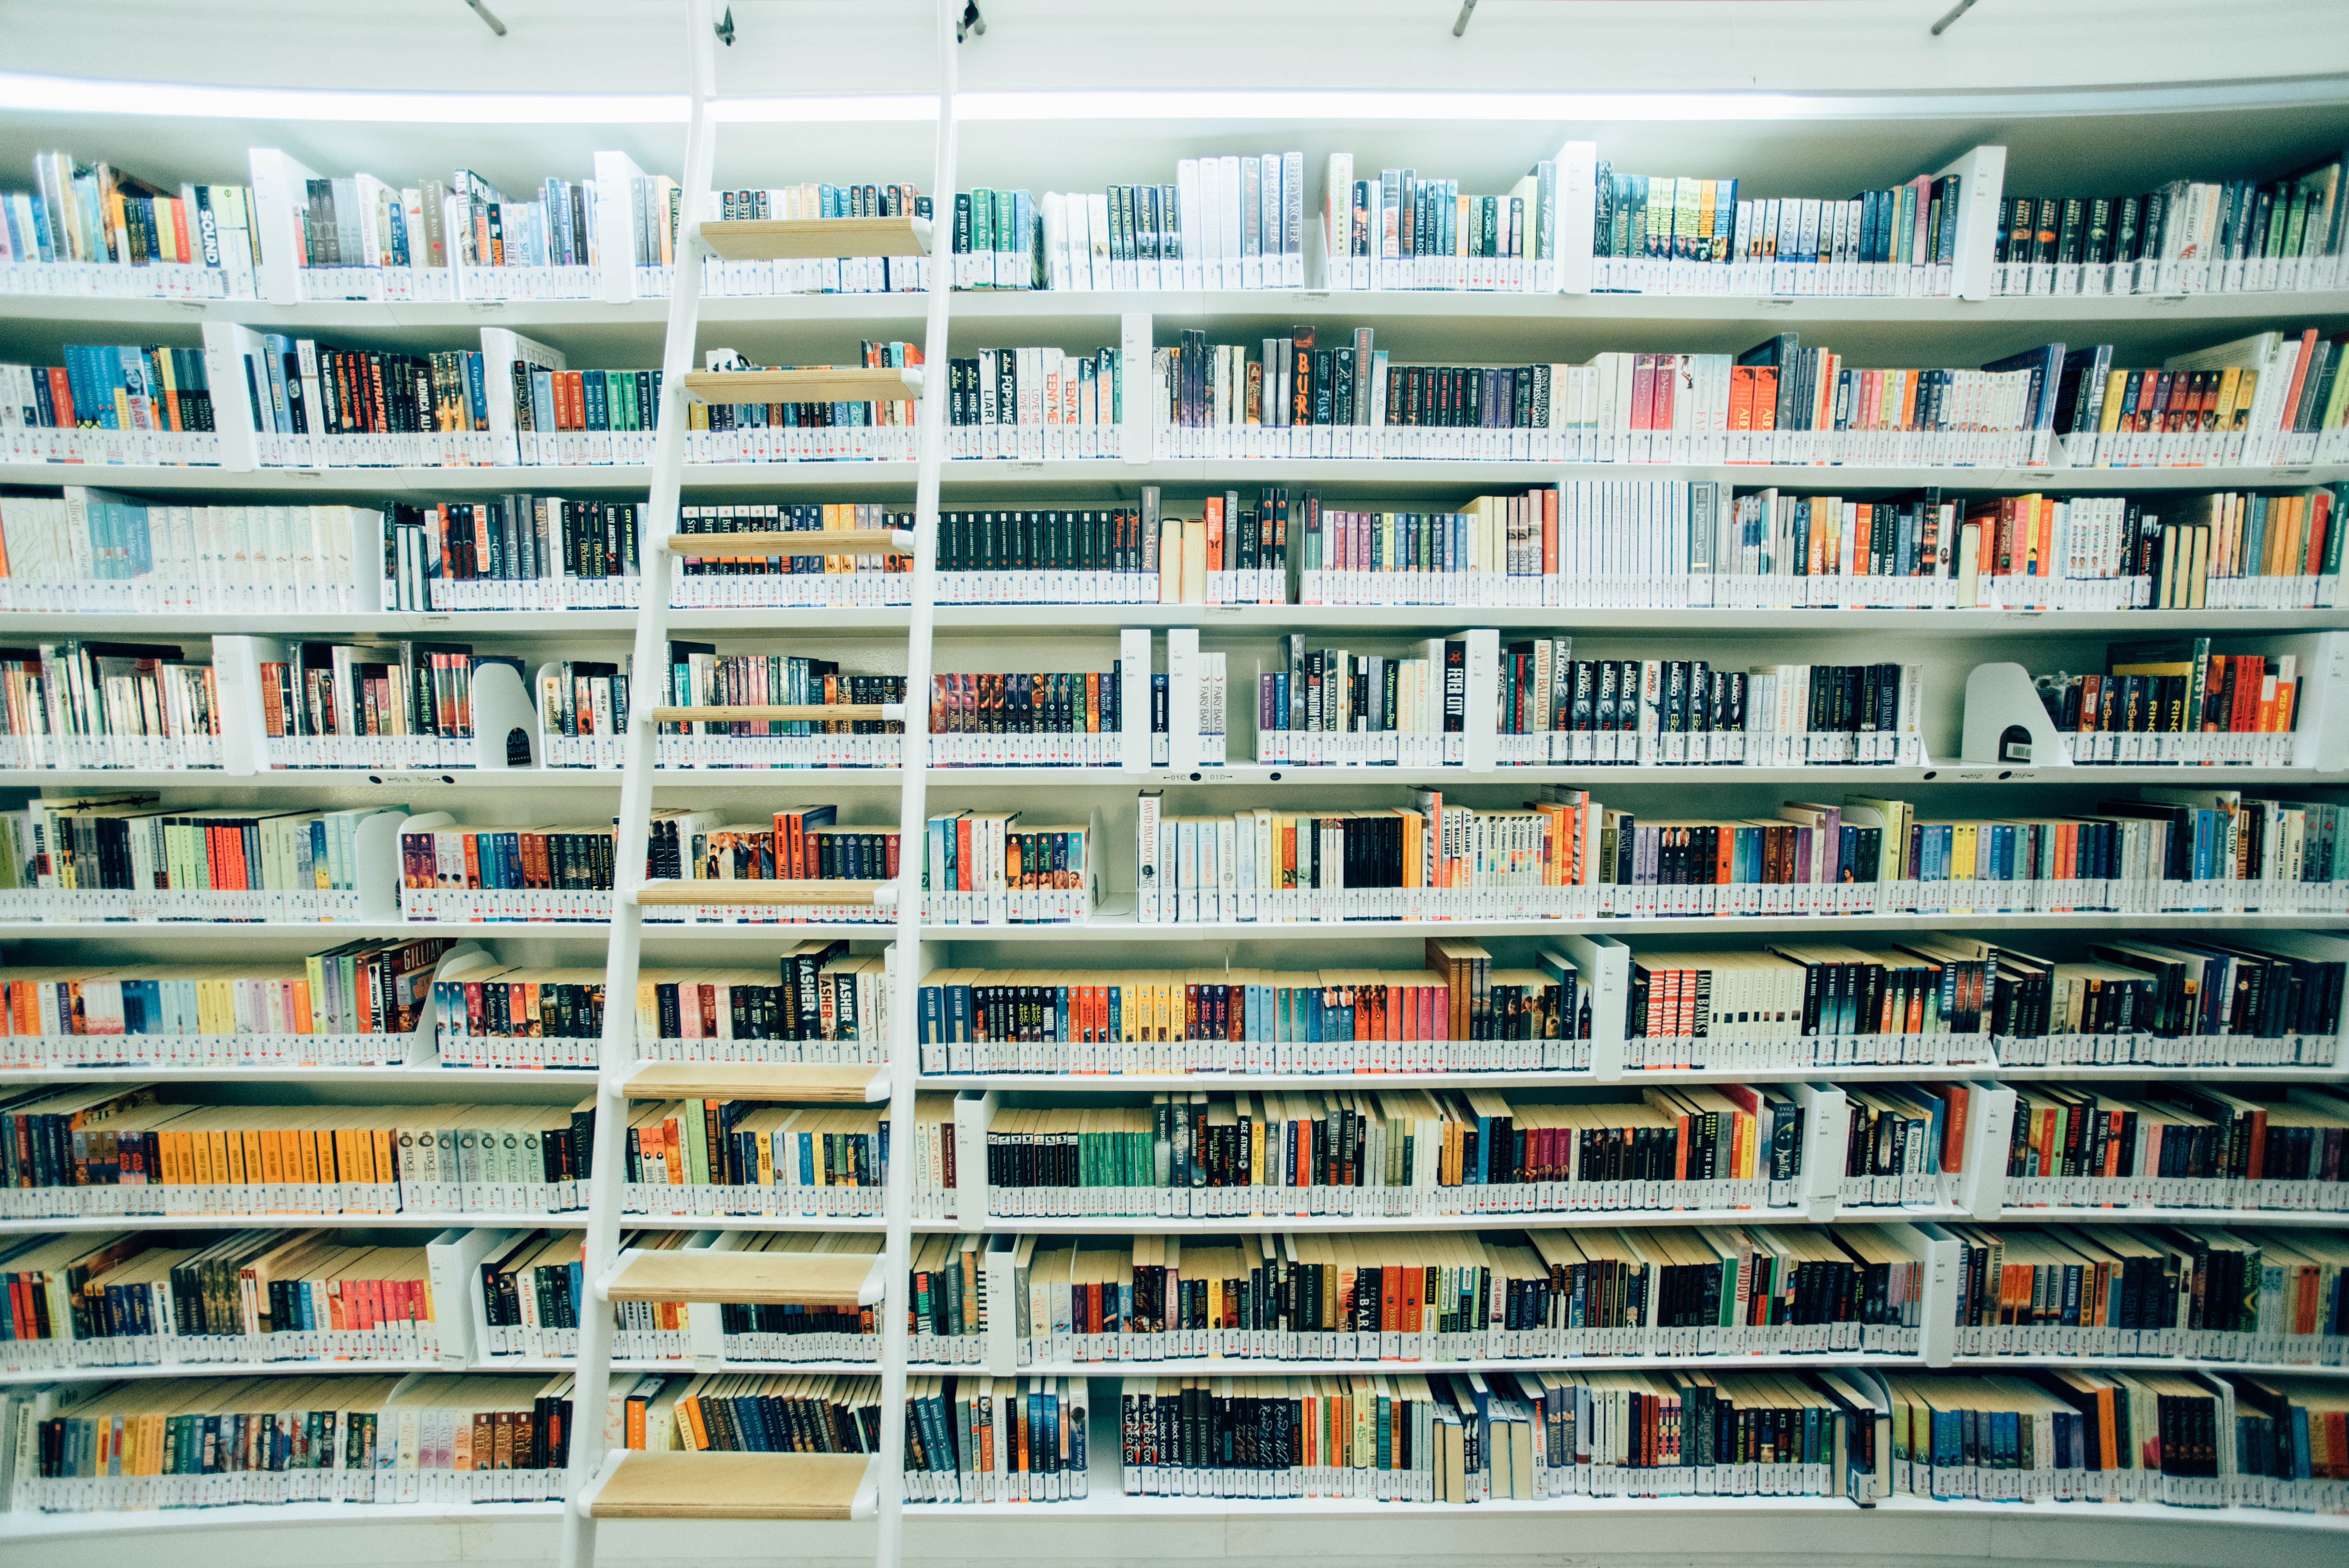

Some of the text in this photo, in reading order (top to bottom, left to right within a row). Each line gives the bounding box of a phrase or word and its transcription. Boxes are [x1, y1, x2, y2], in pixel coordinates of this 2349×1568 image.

[201, 210, 218, 264] SOUND
[1289, 198, 1300, 243] ARCHER
[417, 378, 429, 429] MONICA ALI
[984, 390, 994, 419] LIAR
[1002, 376, 1014, 397] POP
[353, 393, 362, 427] STOCKING
[1020, 413, 1027, 426] ME
[474, 506, 485, 520] THE
[535, 505, 547, 538] DRIVEN
[1226, 497, 1237, 534] FORSAKEN
[608, 525, 616, 554] ARMSTRONG
[1142, 534, 1155, 569] Rising
[1447, 668, 1464, 715] FEVER CITY
[1537, 645, 1550, 725] DAVID BALDACCI
[1200, 686, 1209, 725] FAIRY BAD
[1308, 685, 1321, 732] PHANTOM PAIN
[1144, 800, 1153, 863] DAVID BALDACCI
[2228, 827, 2237, 854] GLOW
[1603, 846, 1611, 875] TWILIGHT
[403, 939, 443, 970] GILLIAN
[800, 965, 816, 1012] ASHER
[820, 979, 832, 1018] ASHER
[839, 983, 852, 1021] ASHER
[1696, 974, 1711, 1033] IAIN BANKS
[1883, 988, 1892, 1020] BANKS
[1943, 965, 1955, 1011] IAIN BANKS
[371, 1005, 382, 1030] TIME
[784, 986, 795, 1029] DEPARTURE
[1647, 976, 1664, 1039] IAIN BANKS
[1330, 1124, 1338, 1156] PERFECT SINS
[2068, 1106, 2080, 1147] ABDUCTION
[1907, 1132, 1921, 1175] Alex Barcla
[1736, 1264, 1751, 1302] WIDOW
